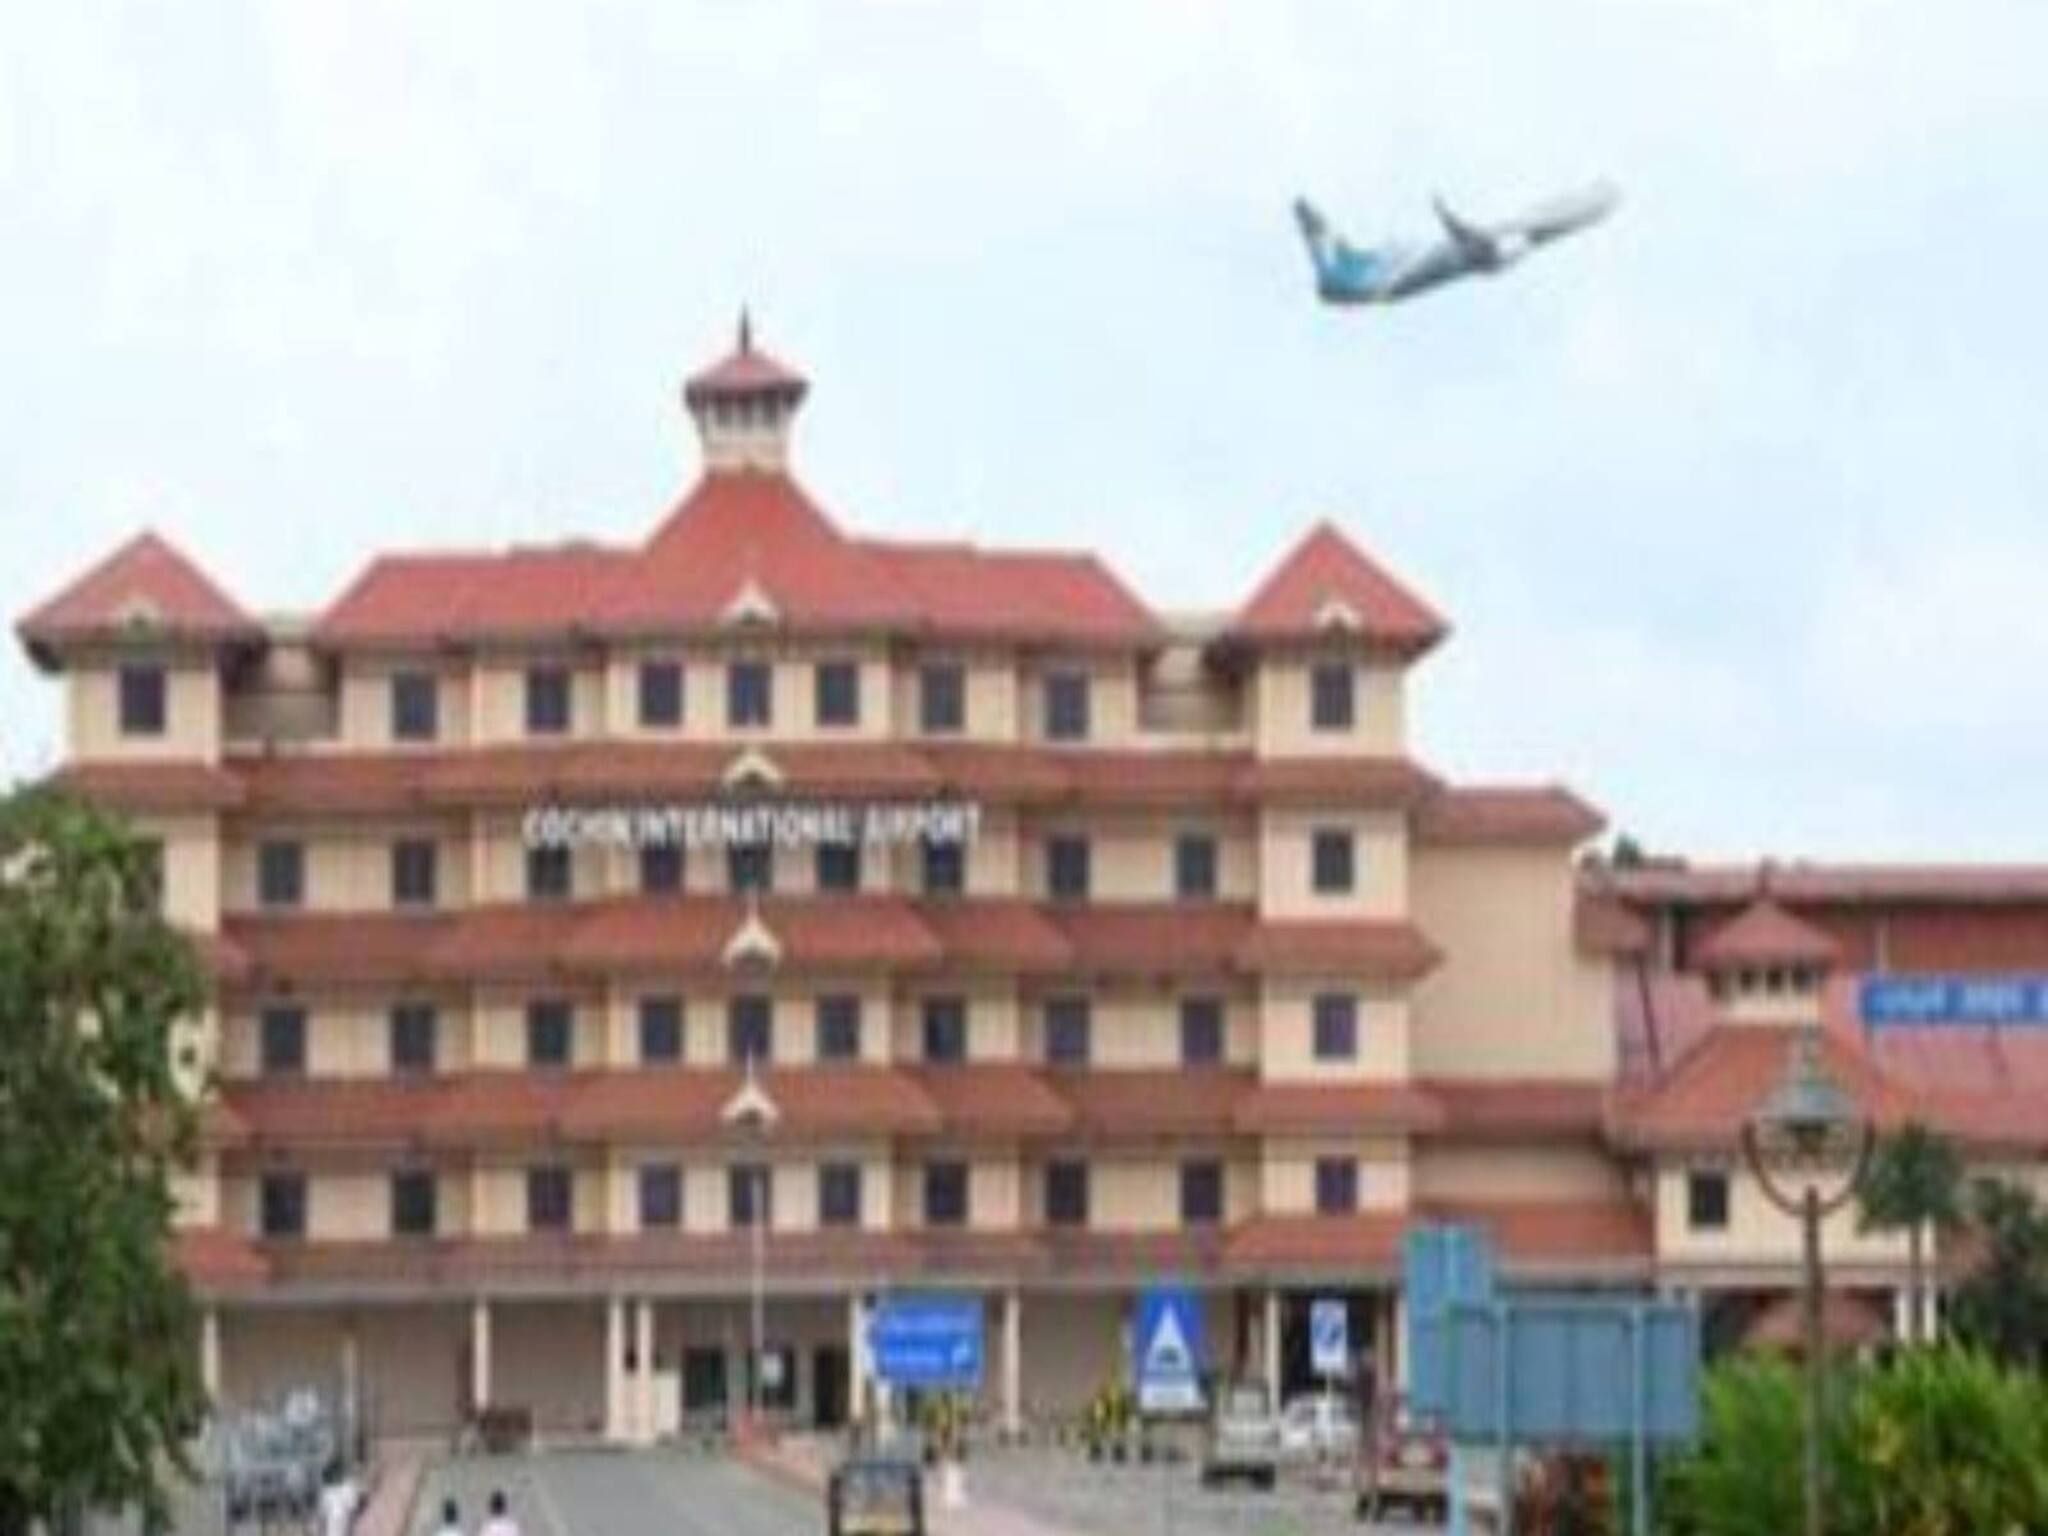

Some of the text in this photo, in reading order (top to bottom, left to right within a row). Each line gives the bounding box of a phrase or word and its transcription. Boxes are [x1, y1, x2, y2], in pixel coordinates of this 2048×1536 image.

[522, 802, 981, 852] COCHIN INTERNATIONAL AIRPORT
